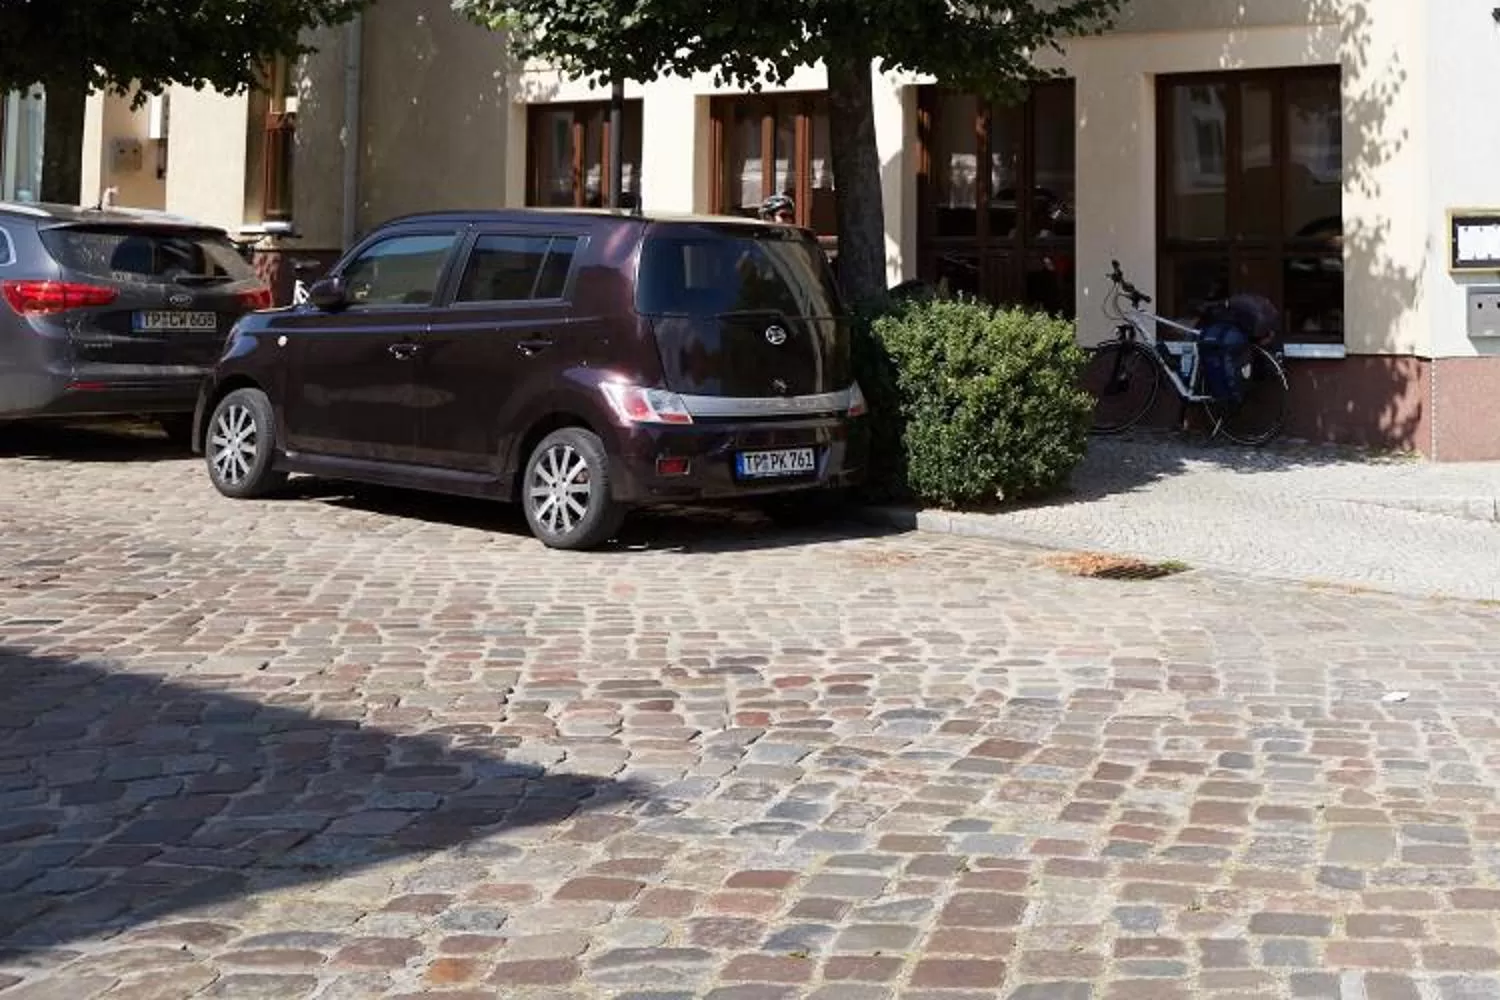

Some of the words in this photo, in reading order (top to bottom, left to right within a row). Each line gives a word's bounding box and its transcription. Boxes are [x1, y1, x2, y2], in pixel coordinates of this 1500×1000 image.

[745, 454, 761, 472] TP
[770, 452, 787, 469] PK
[790, 451, 813, 467] 761
